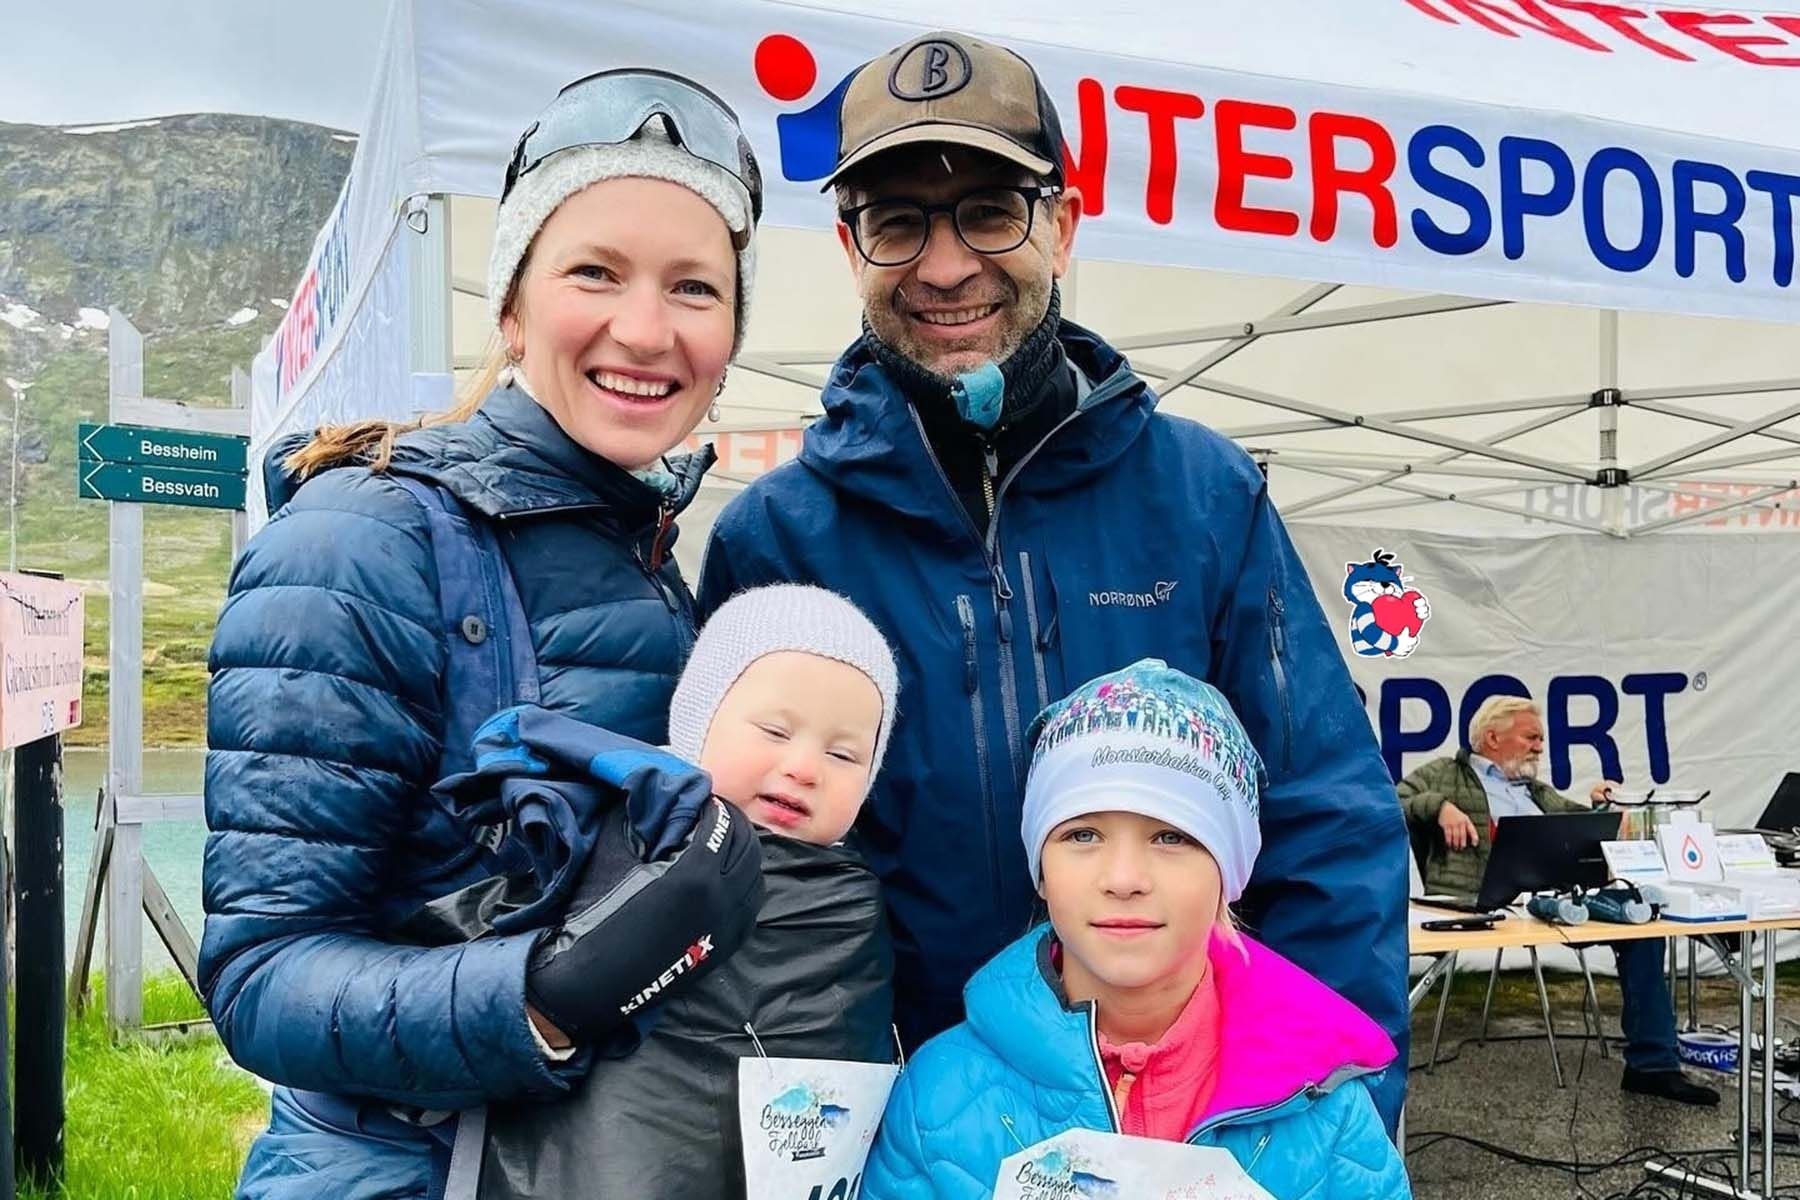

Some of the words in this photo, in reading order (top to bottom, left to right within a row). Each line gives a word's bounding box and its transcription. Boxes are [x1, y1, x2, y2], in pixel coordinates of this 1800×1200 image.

[1409, 0, 1800, 67] INTE
[922, 44, 949, 92] B
[141, 440, 217, 460] Bessheim
[142, 477, 219, 498] Bessvatn
[1089, 591, 1157, 607] NORRØNA
[1355, 672, 1688, 790] PRT
